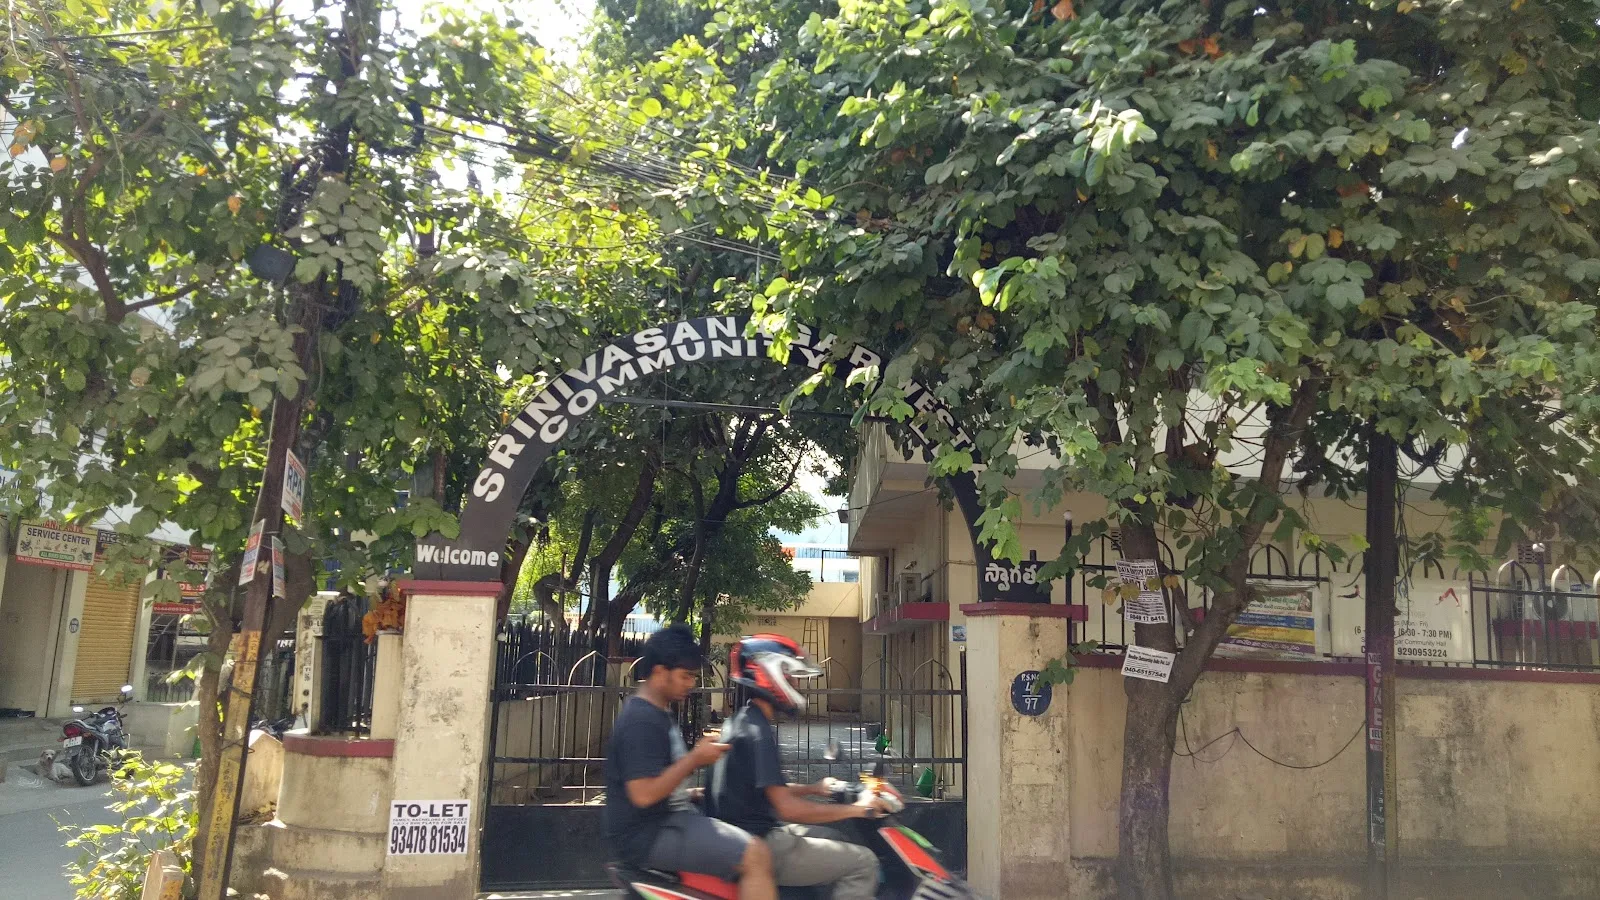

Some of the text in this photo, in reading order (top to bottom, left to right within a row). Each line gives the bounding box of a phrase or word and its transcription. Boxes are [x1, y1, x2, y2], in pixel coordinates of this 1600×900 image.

[27, 527, 60, 540] SERVICE
[62, 533, 90, 546] CENTER
[417, 545, 499, 567] Welcome
[1422, 629, 1437, 638] 7:30
[1438, 630, 1452, 640] PM)
[1397, 647, 1447, 658] 9290953224
[1024, 697, 1038, 710] 97
[394, 804, 467, 818] TO-LET
[391, 825, 466, 854] 93478 81534
